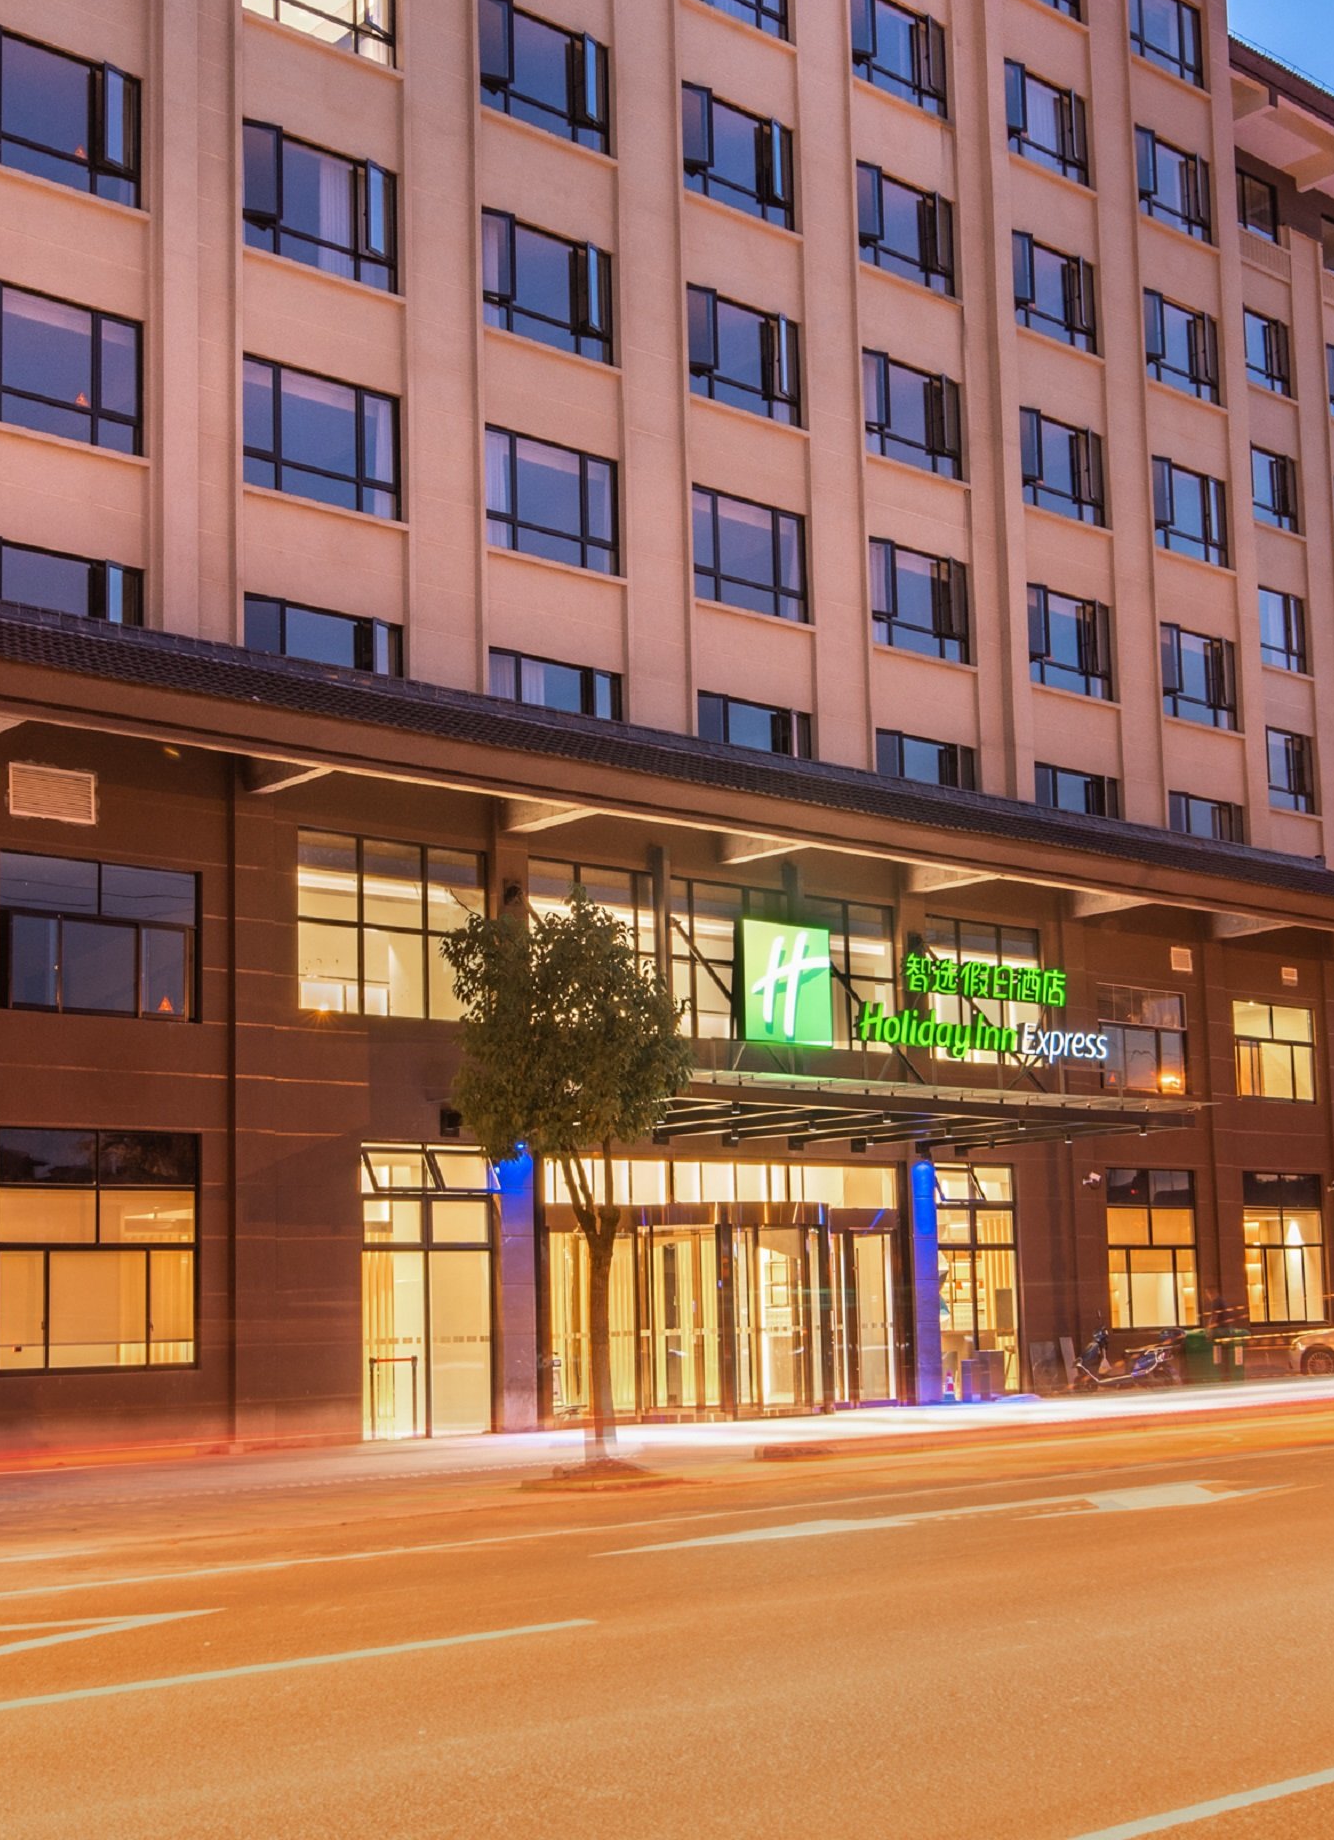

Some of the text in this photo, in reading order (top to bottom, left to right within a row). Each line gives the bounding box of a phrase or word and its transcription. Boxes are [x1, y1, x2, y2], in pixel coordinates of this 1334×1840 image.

[905, 952, 1067, 1007] 智选假日酒店
[857, 1000, 1109, 1064] Holiday Inn Express
